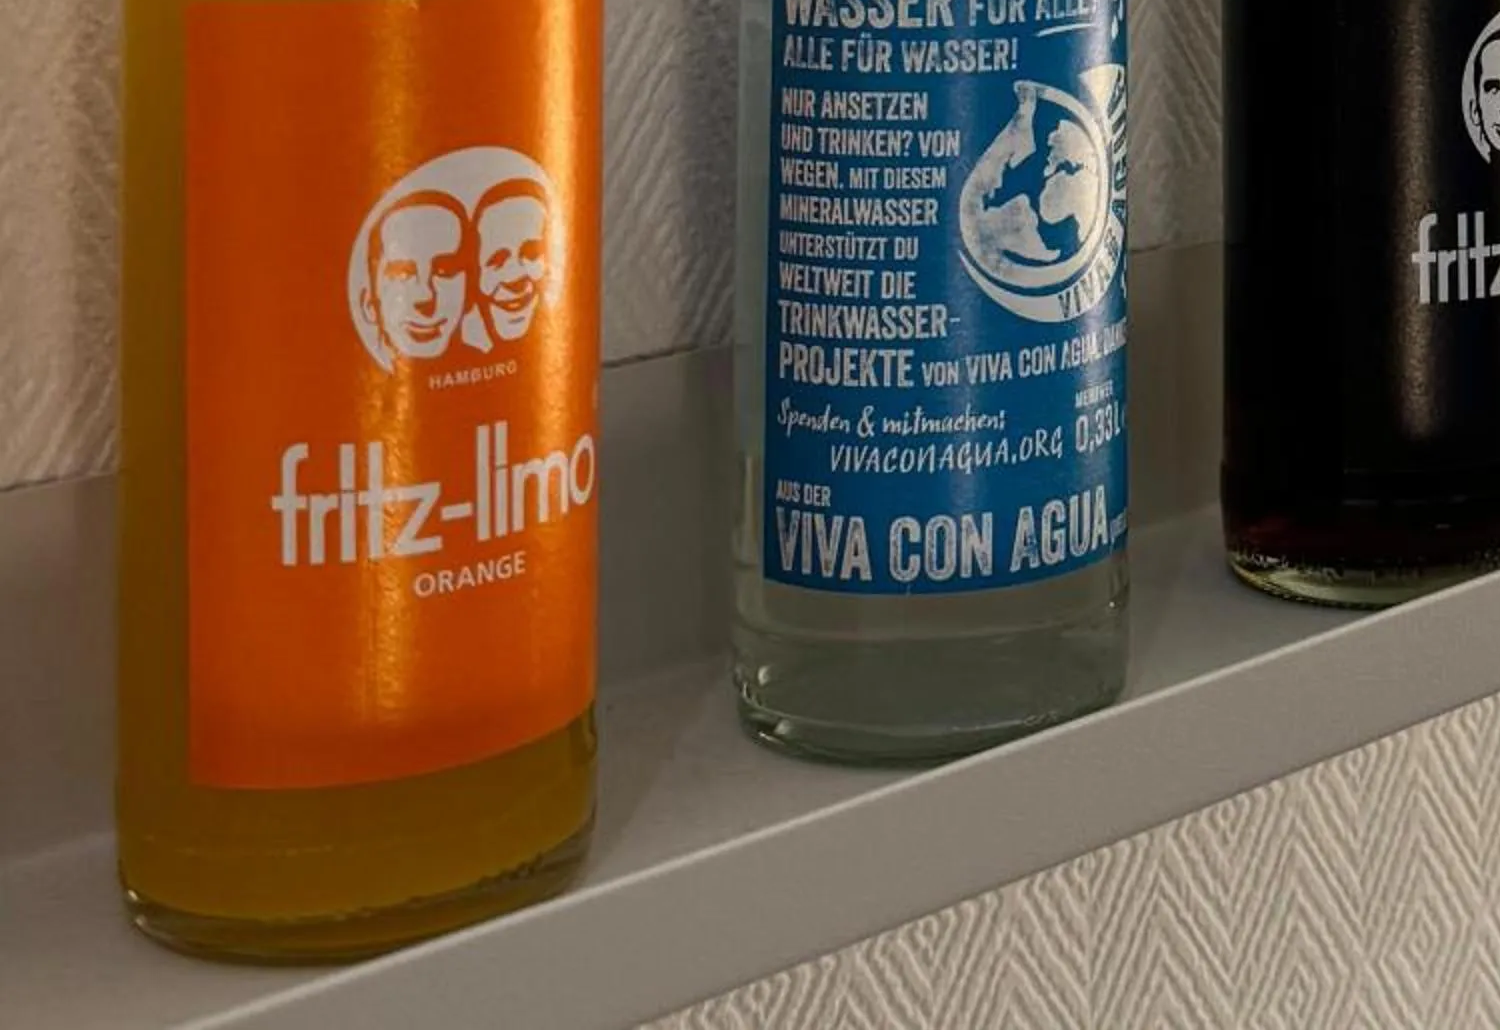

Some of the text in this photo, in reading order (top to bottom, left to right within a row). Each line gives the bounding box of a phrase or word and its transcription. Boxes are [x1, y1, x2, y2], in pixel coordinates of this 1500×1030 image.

[783, 32, 1019, 74] ALLE FÜR WASSER!
[781, 87, 928, 121] NUR ANSETZEN
[781, 122, 960, 158] UND TRINKEN? VON
[780, 157, 947, 189] WEGEN. MIT DIESEM
[779, 195, 939, 227] MINERALWASSER
[779, 231, 919, 261] UNTERSTÜTZT DU
[779, 261, 917, 300] WELTWEIT DIE
[778, 300, 961, 341] TRINKWASSER-
[778, 341, 915, 389] PROJEKTE
[922, 361, 960, 388] VON
[965, 351, 1014, 386] VIVA
[1018, 343, 1057, 379] CON
[777, 397, 850, 439] Spenden
[857, 404, 876, 439] &
[271, 420, 597, 567] fritz-limo
[775, 478, 831, 507] AUS DER
[775, 506, 873, 582] VIVA
[889, 511, 994, 583] CON
[1009, 484, 1109, 573] AGUA
[413, 551, 527, 599] ORANGE
